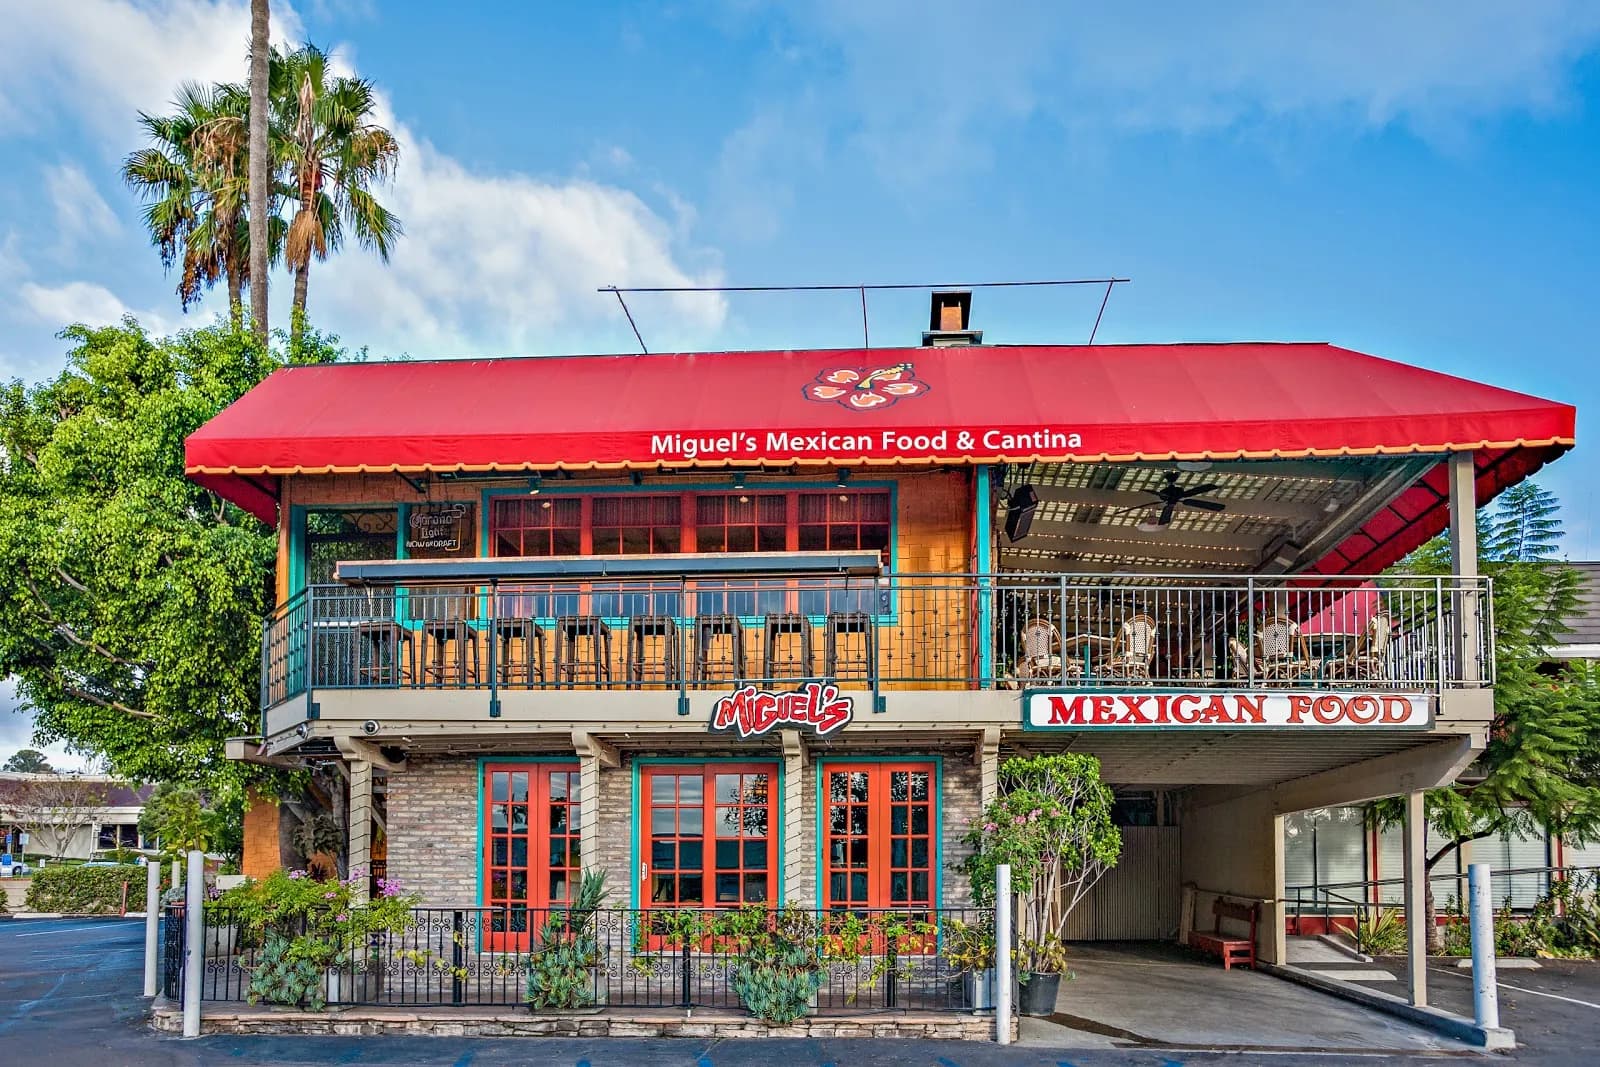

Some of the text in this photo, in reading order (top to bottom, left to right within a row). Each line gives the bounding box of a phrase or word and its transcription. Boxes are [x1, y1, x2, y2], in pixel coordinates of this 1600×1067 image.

[650, 428, 1082, 459] Miguel's Mexican Food & Cantina
[410, 514, 452, 528] Corona
[421, 528, 444, 538] Light
[1047, 694, 1413, 725] MEXICAN FOOD
